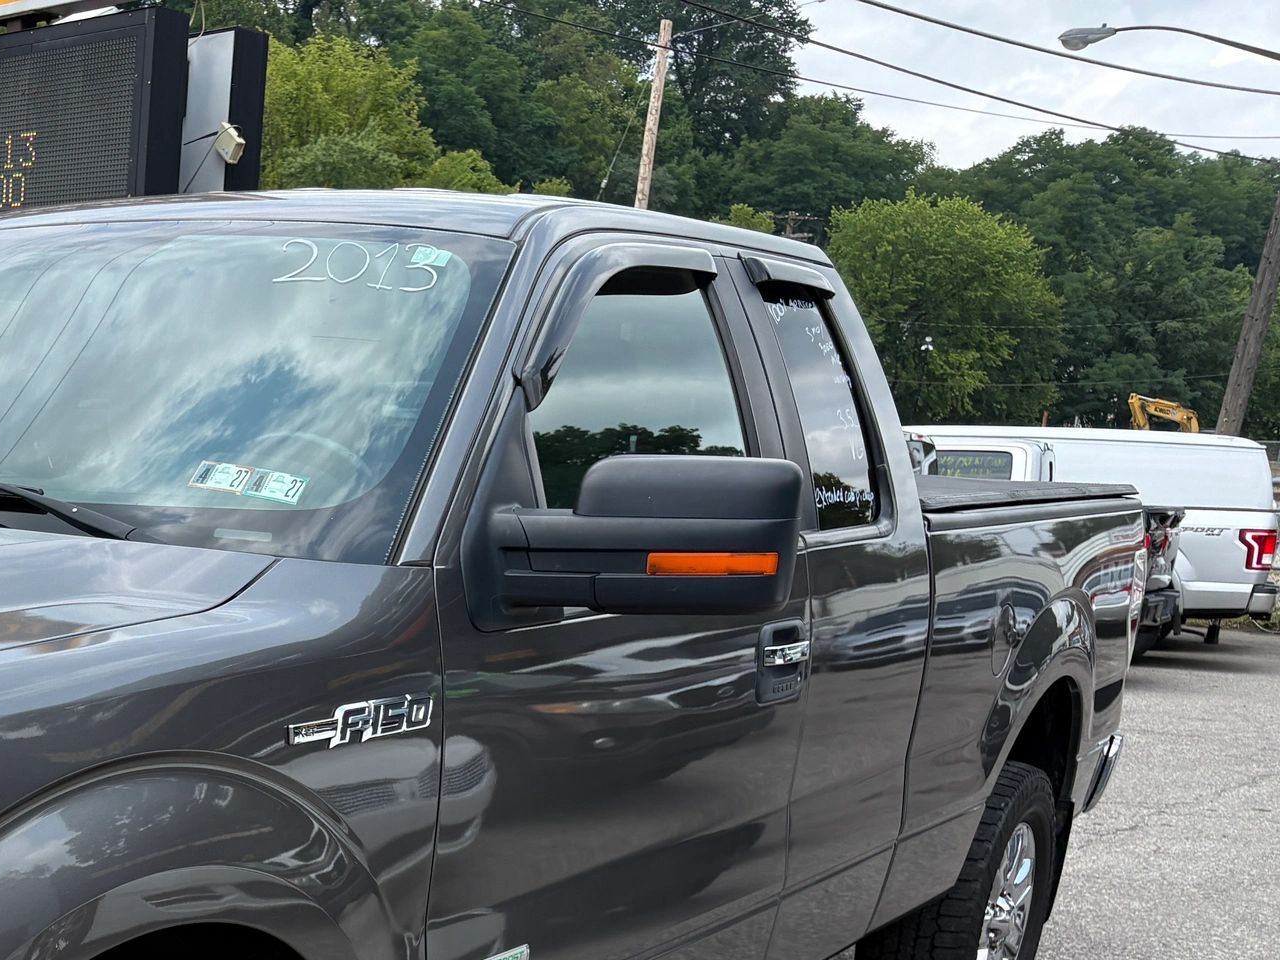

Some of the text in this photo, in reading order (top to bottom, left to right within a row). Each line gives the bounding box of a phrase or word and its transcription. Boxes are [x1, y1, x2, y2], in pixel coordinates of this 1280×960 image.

[272, 238, 438, 291] 2013
[229, 469, 250, 489] 27
[284, 478, 305, 499] 27
